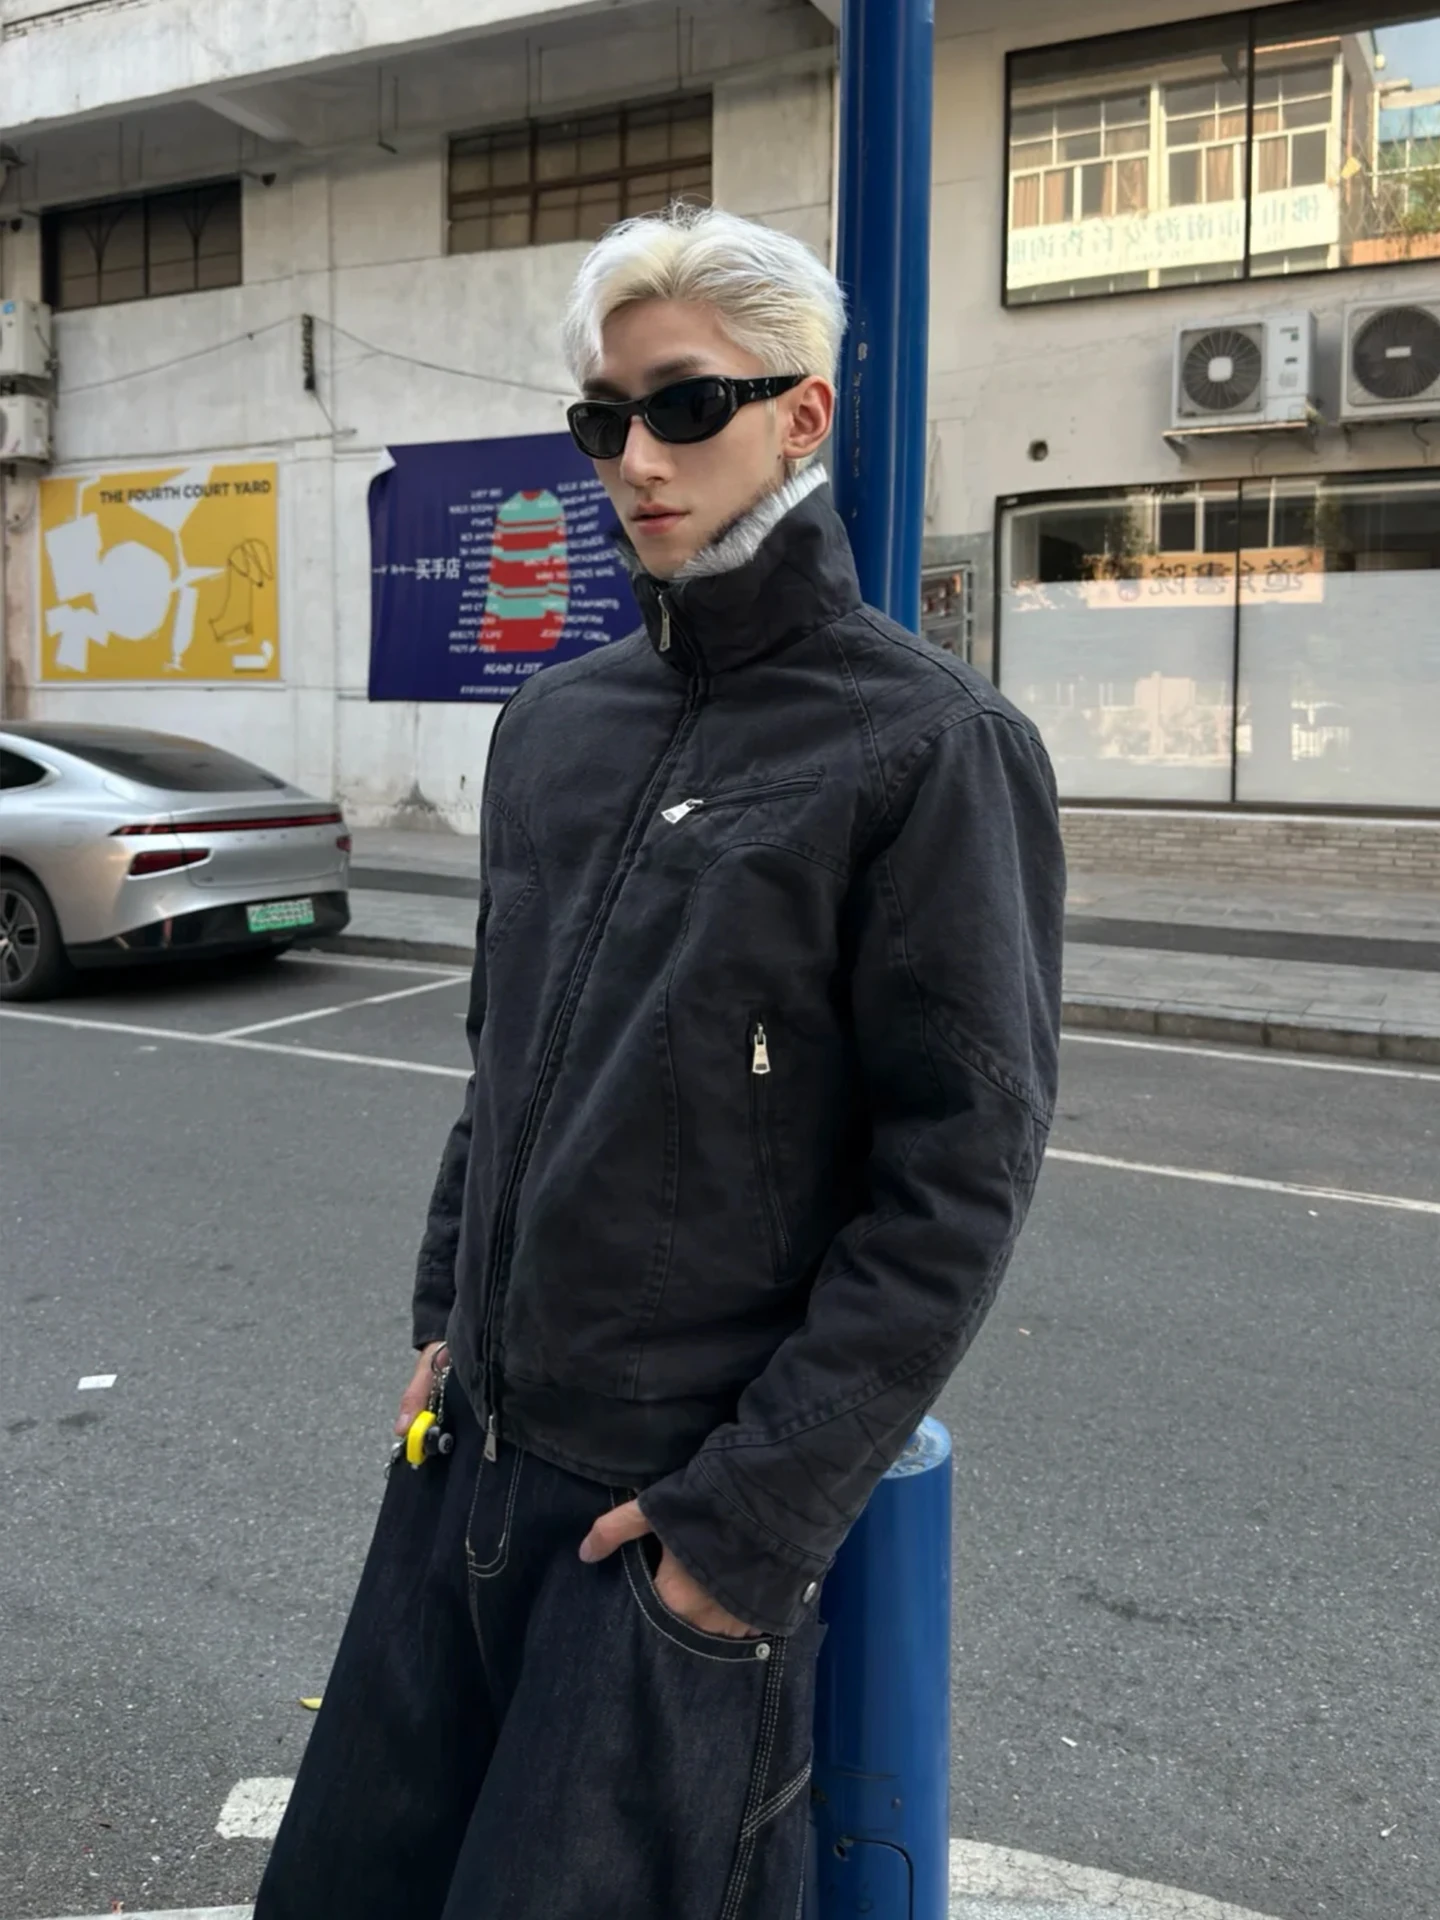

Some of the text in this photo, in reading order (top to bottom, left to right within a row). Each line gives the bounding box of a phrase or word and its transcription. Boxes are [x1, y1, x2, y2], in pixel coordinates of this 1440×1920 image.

[100, 480, 271, 503] THE FOURTH COURT YARD
[415, 557, 460, 580] 买手店
[515, 662, 543, 675] LIST
